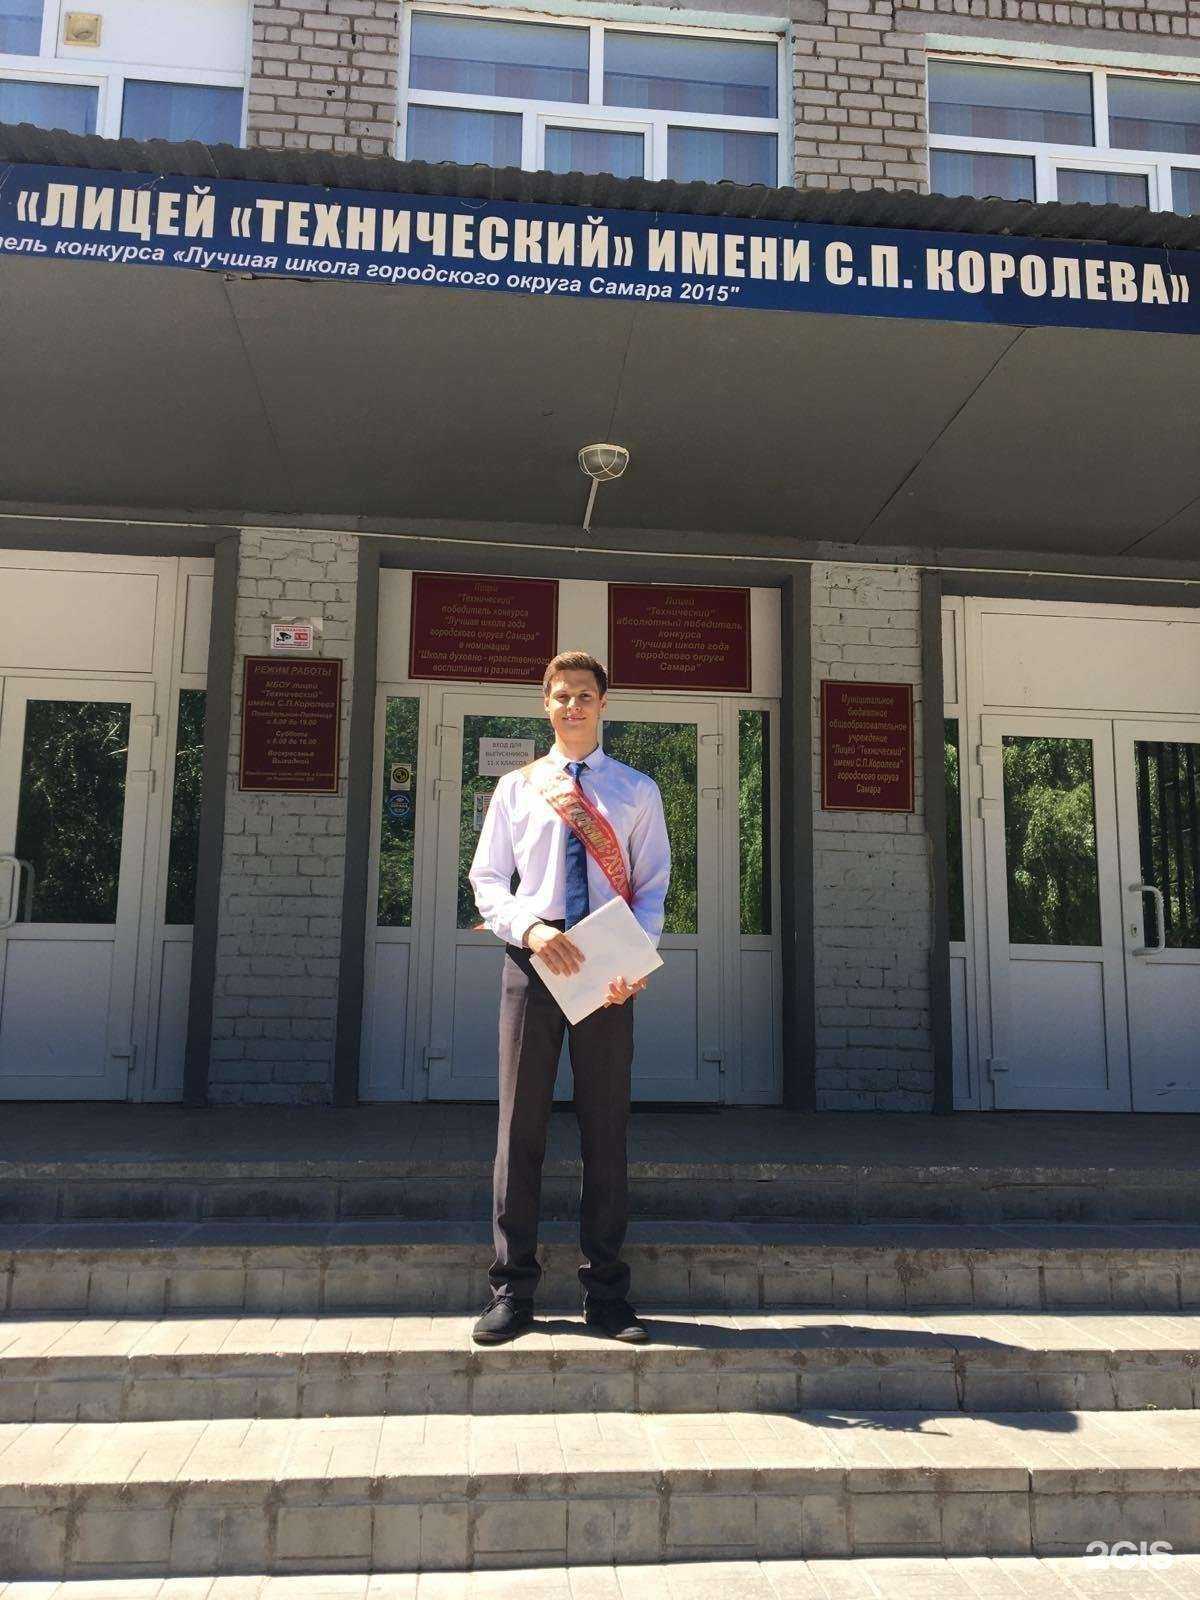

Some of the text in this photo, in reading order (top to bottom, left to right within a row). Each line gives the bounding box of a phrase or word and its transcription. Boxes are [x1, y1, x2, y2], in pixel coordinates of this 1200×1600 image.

[16, 182, 1190, 305] «ЛИЦЕЙ «ТЕХНИЧЕСКИЙ» ИМЕНИ С.П. КОРОЛЕВА»
[55, 240, 165, 263] конкурса
[173, 246, 277, 270] «Лучшая
[285, 257, 360, 276] школа
[366, 262, 499, 287] городского
[506, 274, 582, 295] округа
[589, 277, 673, 301] Самара
[680, 283, 740, 302] 2015"
[616, 617, 682, 628] абсолютный
[658, 630, 702, 640] конкурса
[632, 639, 730, 651] "Лучшая школа года
[636, 650, 725, 663] городского округа
[291, 666, 332, 677] РАБОТЫ
[660, 662, 701, 673] Самара"
